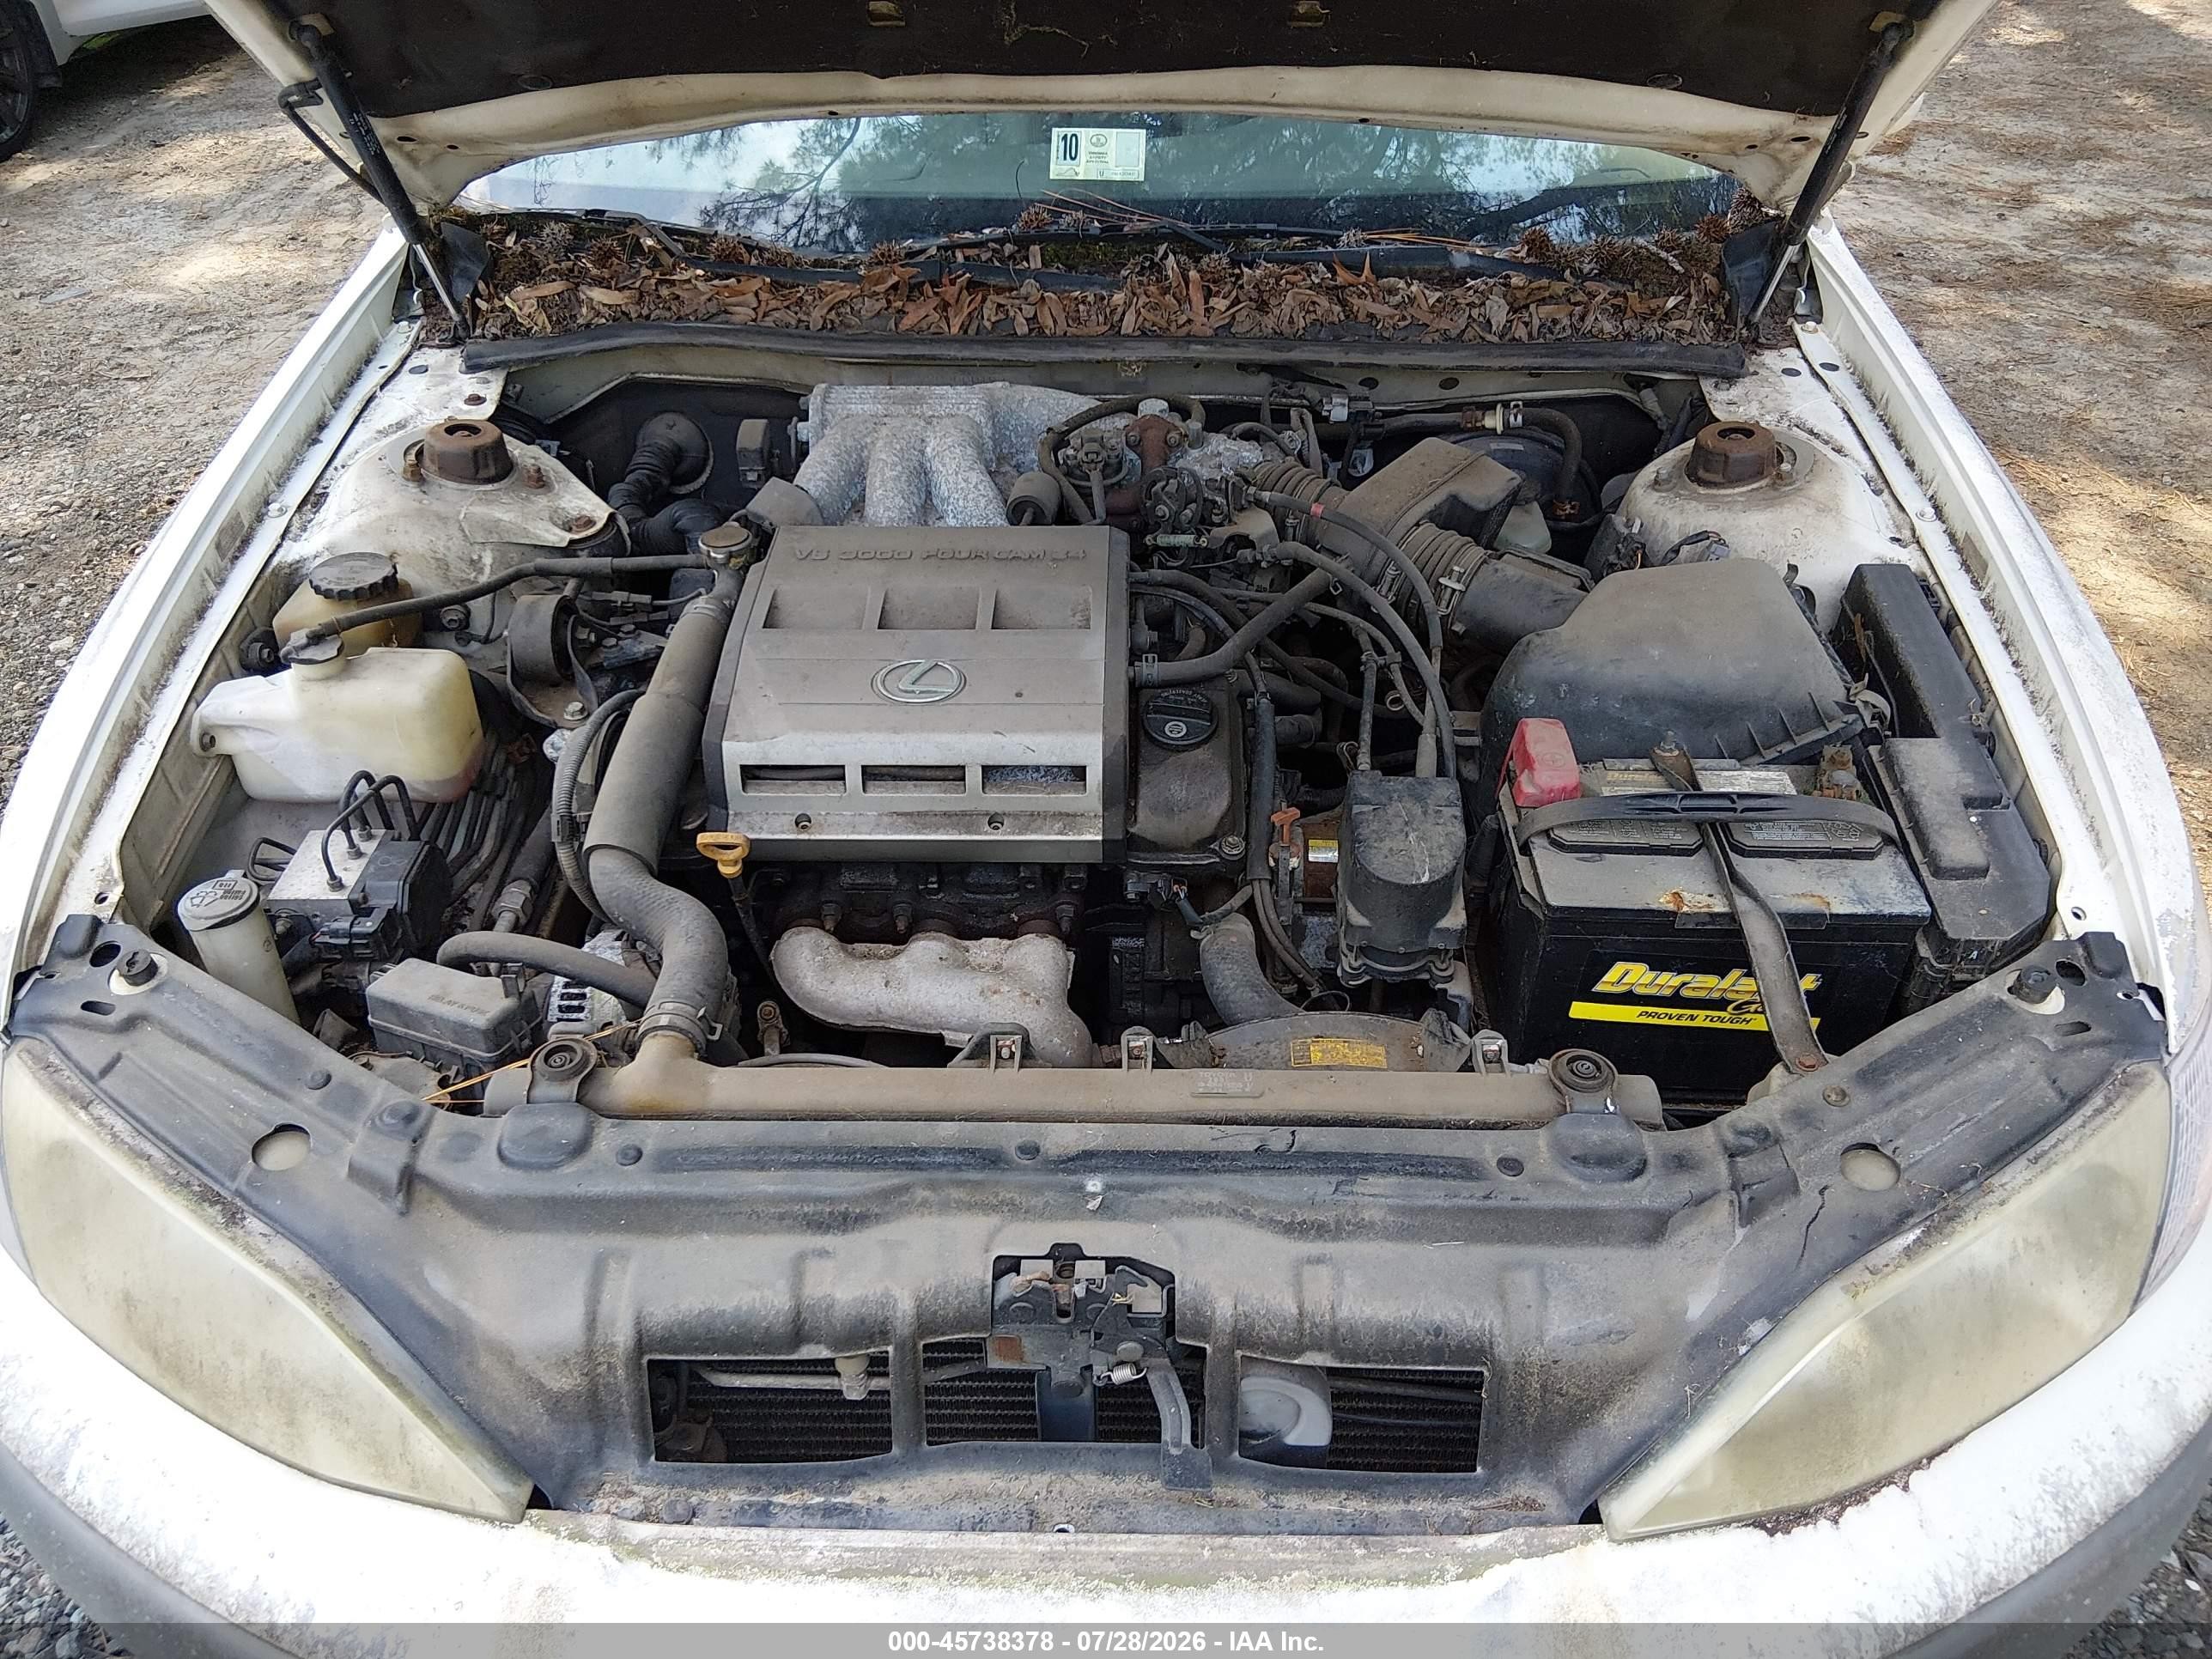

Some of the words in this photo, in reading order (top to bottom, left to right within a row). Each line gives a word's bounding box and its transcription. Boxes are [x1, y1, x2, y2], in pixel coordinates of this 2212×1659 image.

[1060, 133, 1079, 161] 10
[921, 548, 988, 561] FOUR
[993, 548, 1046, 561] CAM
[1592, 961, 1822, 1001] Duralat
[1636, 1010, 1699, 1022] PROVEN
[1701, 1014, 1753, 1025] TOUGH
